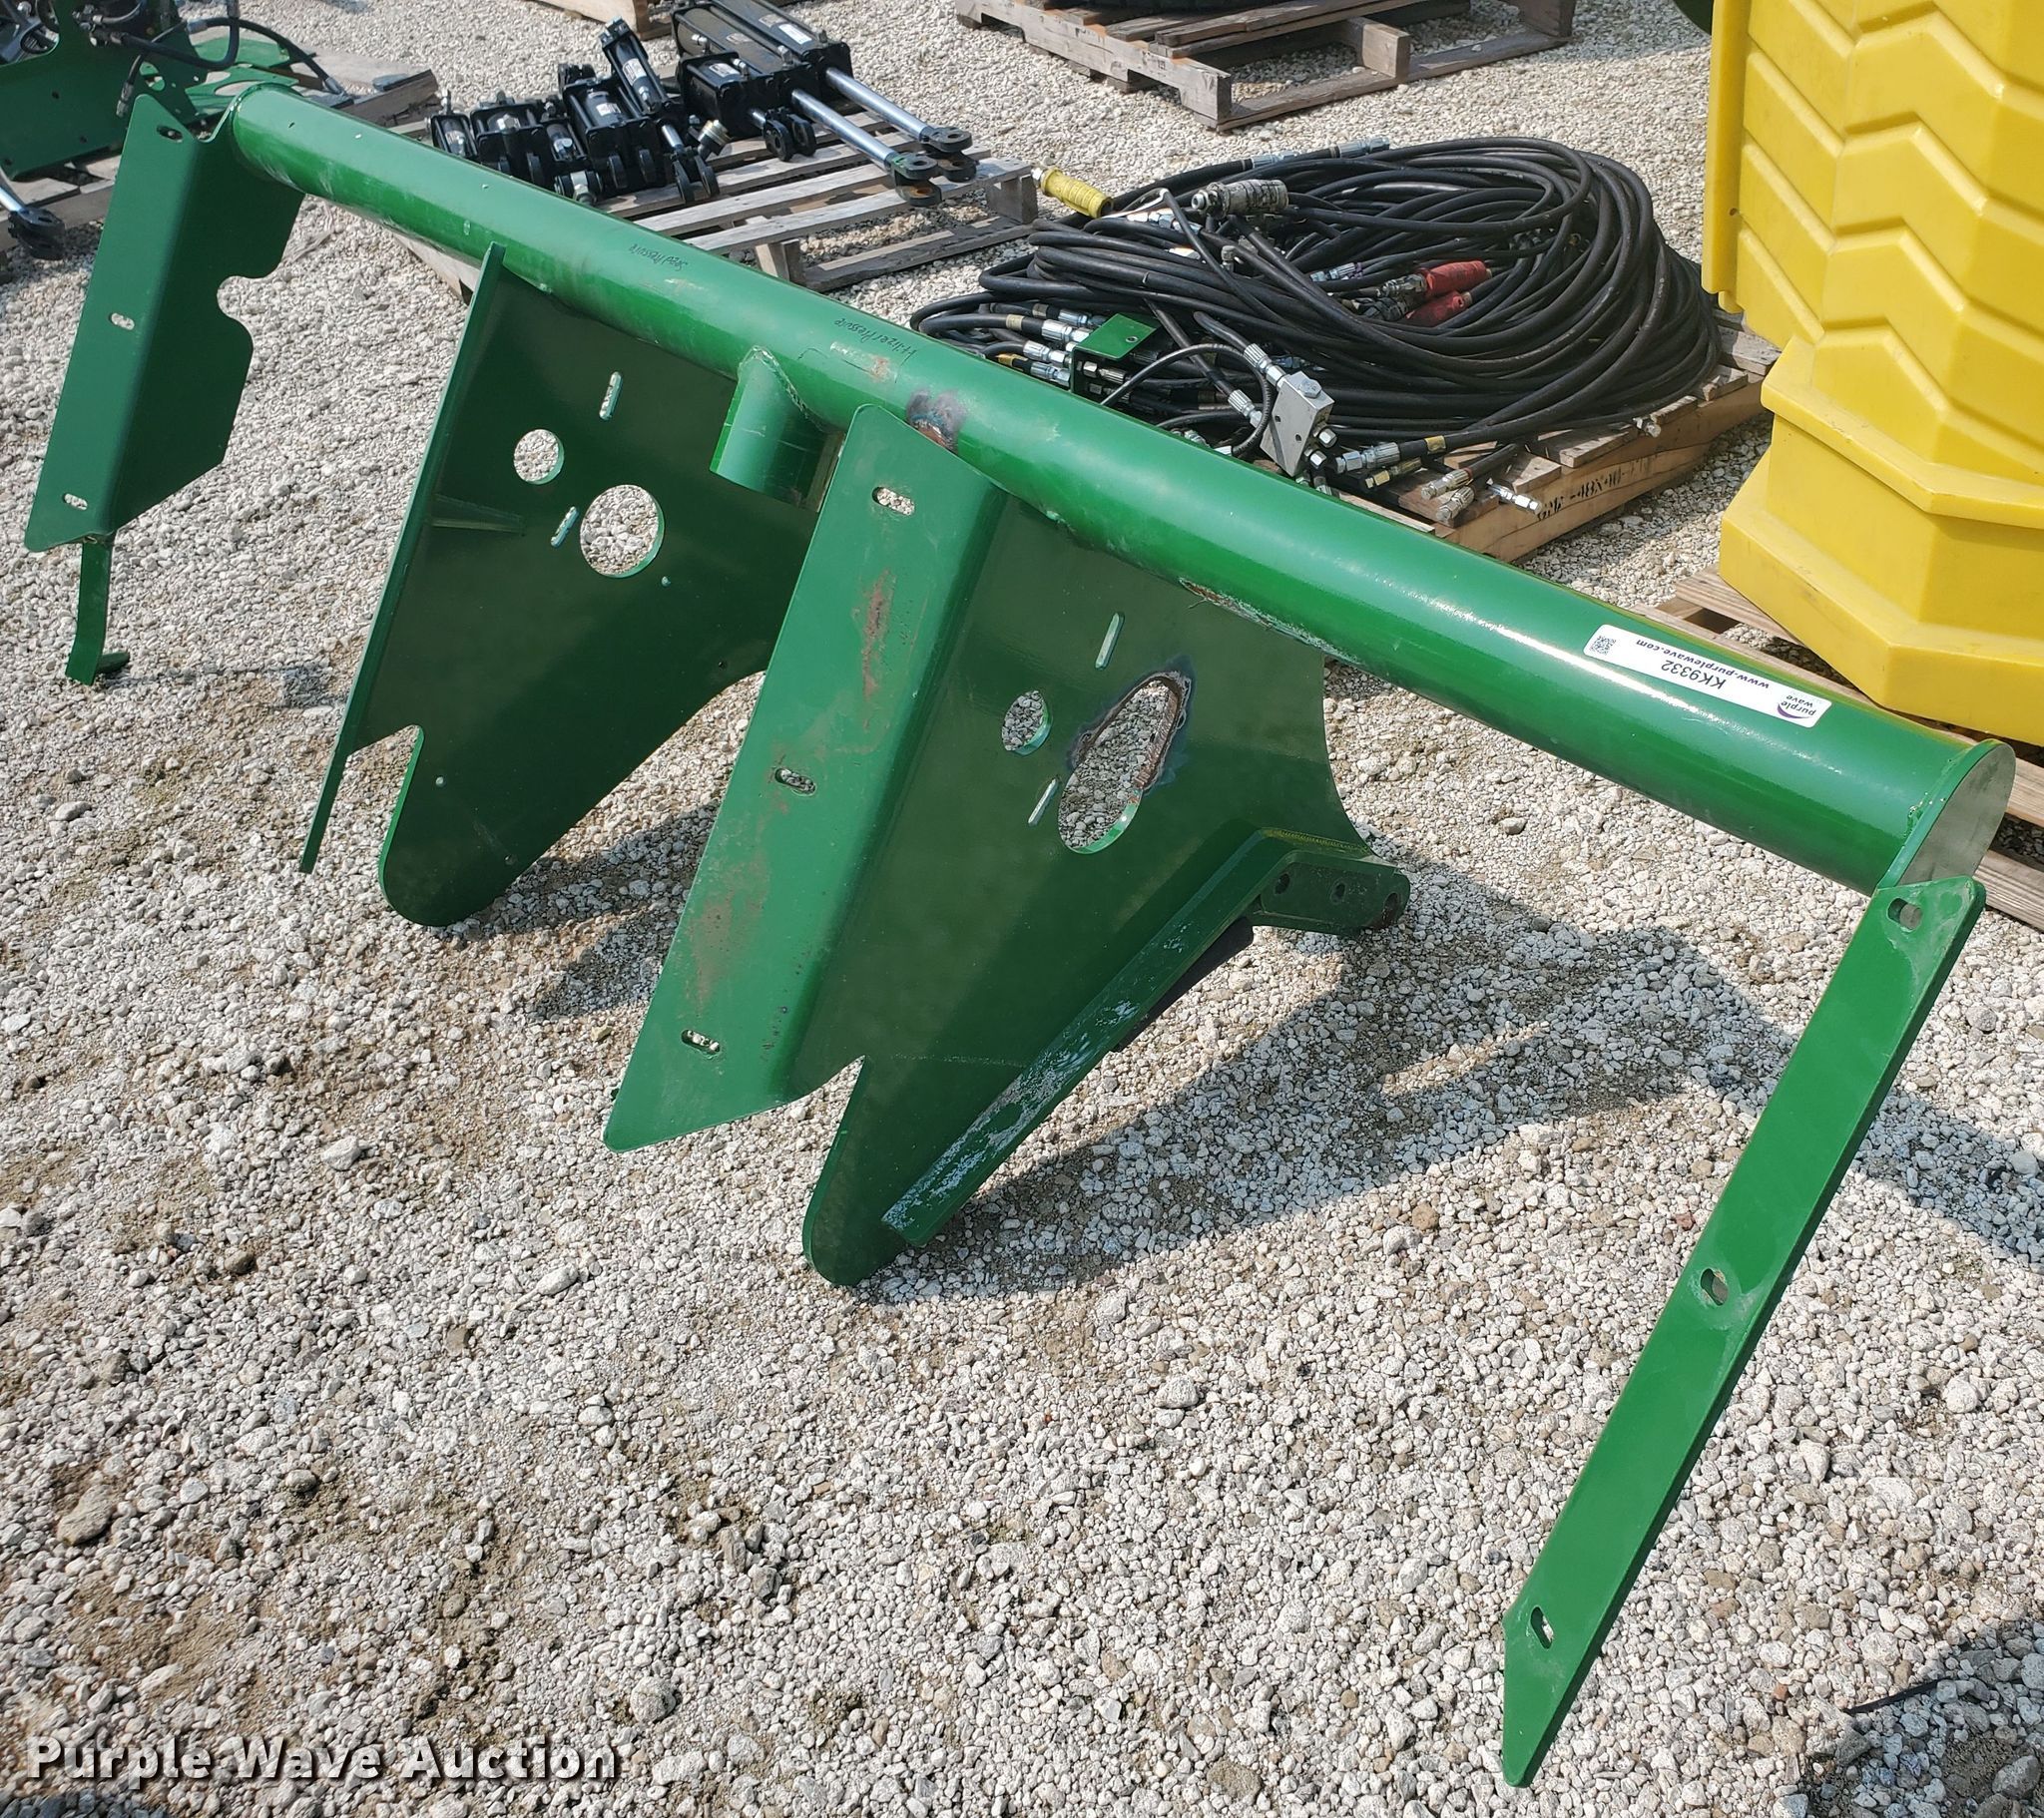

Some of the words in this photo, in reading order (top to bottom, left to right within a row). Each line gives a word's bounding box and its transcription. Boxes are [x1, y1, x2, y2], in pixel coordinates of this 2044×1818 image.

[1636, 639, 1770, 689] www.purplewave.com
[1661, 660, 1727, 689] KK9332
[1781, 700, 1816, 716] purple
[1786, 694, 1813, 707] wave
